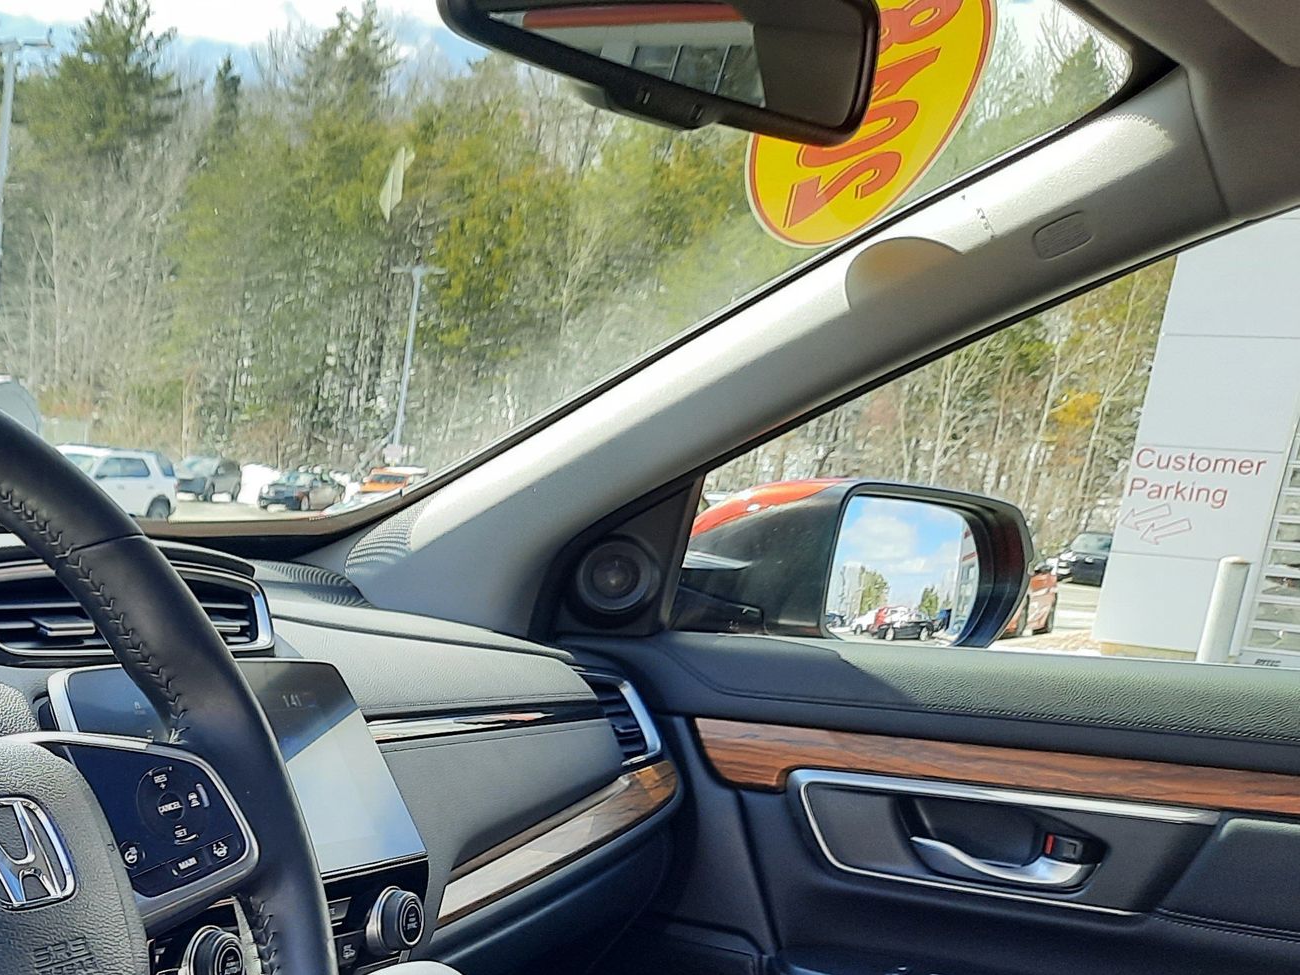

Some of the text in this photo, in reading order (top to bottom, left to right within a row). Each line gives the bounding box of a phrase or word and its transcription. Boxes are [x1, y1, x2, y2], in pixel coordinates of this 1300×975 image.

[1136, 448, 1267, 476] Customer
[1128, 477, 1228, 509] Parking
[154, 774, 167, 783] RES
[158, 801, 182, 815] CANCEL
[175, 828, 187, 837] SET
[179, 858, 197, 869] MAIN
